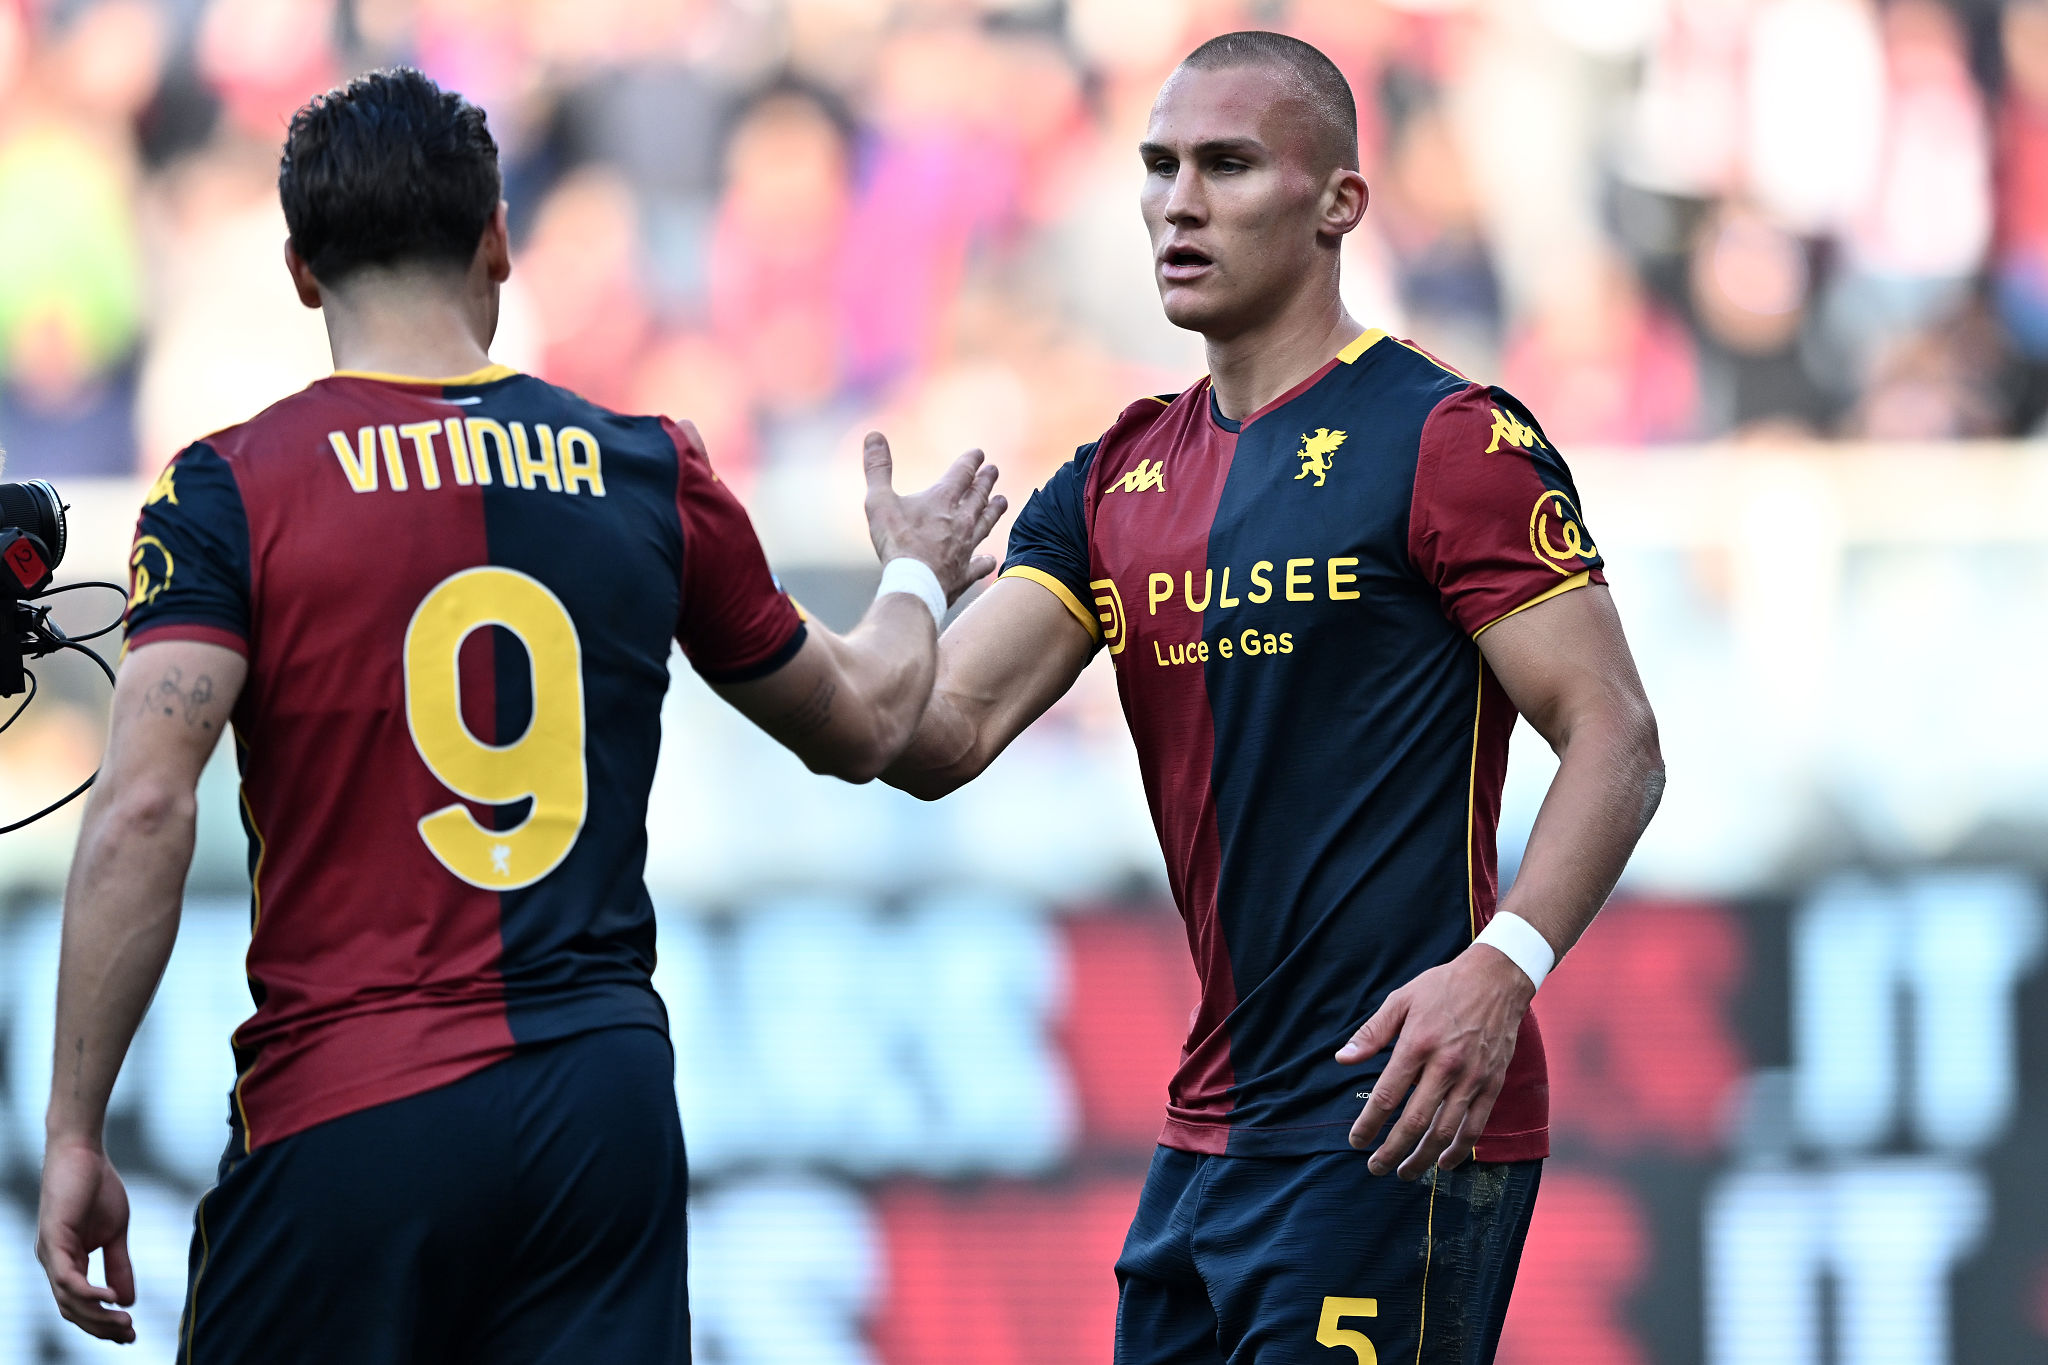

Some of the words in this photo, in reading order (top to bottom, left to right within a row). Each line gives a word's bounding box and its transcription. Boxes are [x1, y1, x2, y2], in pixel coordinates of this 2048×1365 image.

[328, 417, 606, 497] VITINHA
[1148, 557, 1361, 616] PULSEE
[1153, 639, 1209, 666] Luce
[1219, 637, 1233, 659] e
[1240, 628, 1294, 656] Gas
[404, 566, 588, 890] 9
[1316, 1296, 1378, 1365] 5
